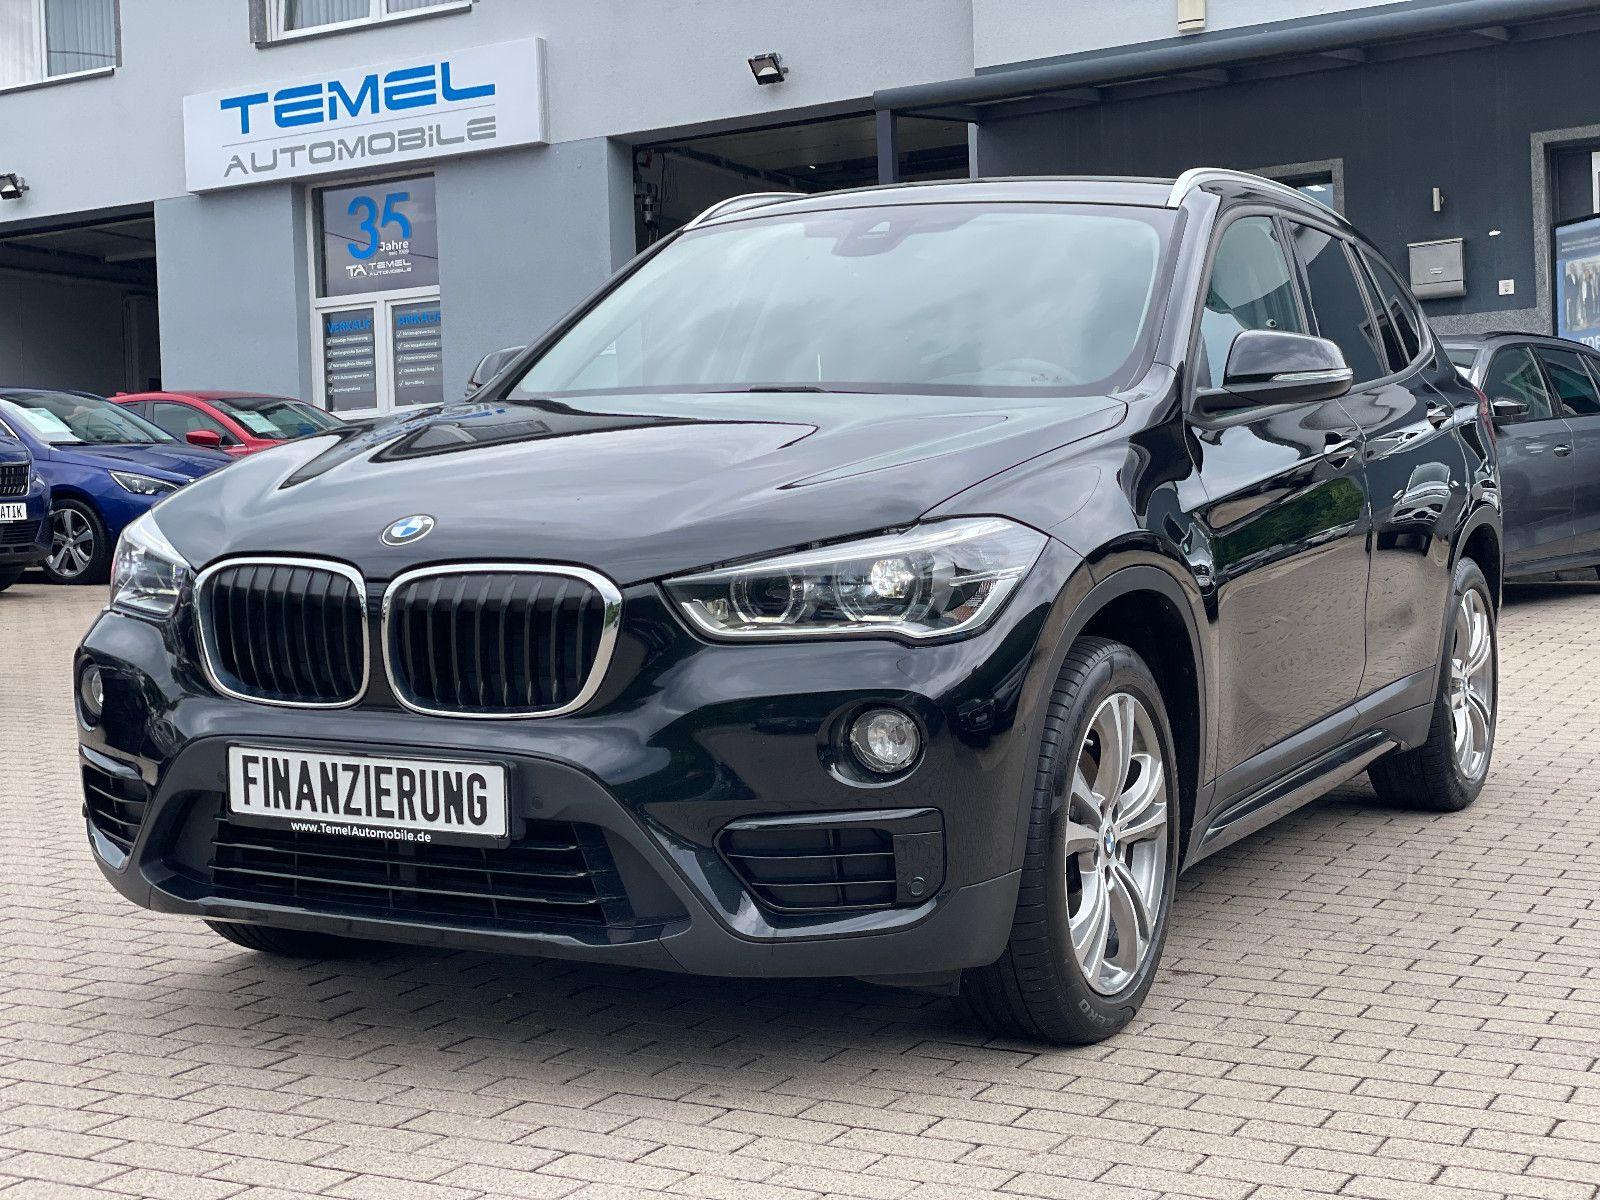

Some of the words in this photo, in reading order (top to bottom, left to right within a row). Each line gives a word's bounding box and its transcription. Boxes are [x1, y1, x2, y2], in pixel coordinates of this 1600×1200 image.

[220, 61, 496, 135] TEMEL
[347, 191, 413, 260] 35
[379, 240, 409, 252] Jahre
[369, 258, 412, 270] TEMEL
[241, 754, 488, 826] FINANZIERUNG
[290, 821, 432, 843] www.TemelAutomobile.de
